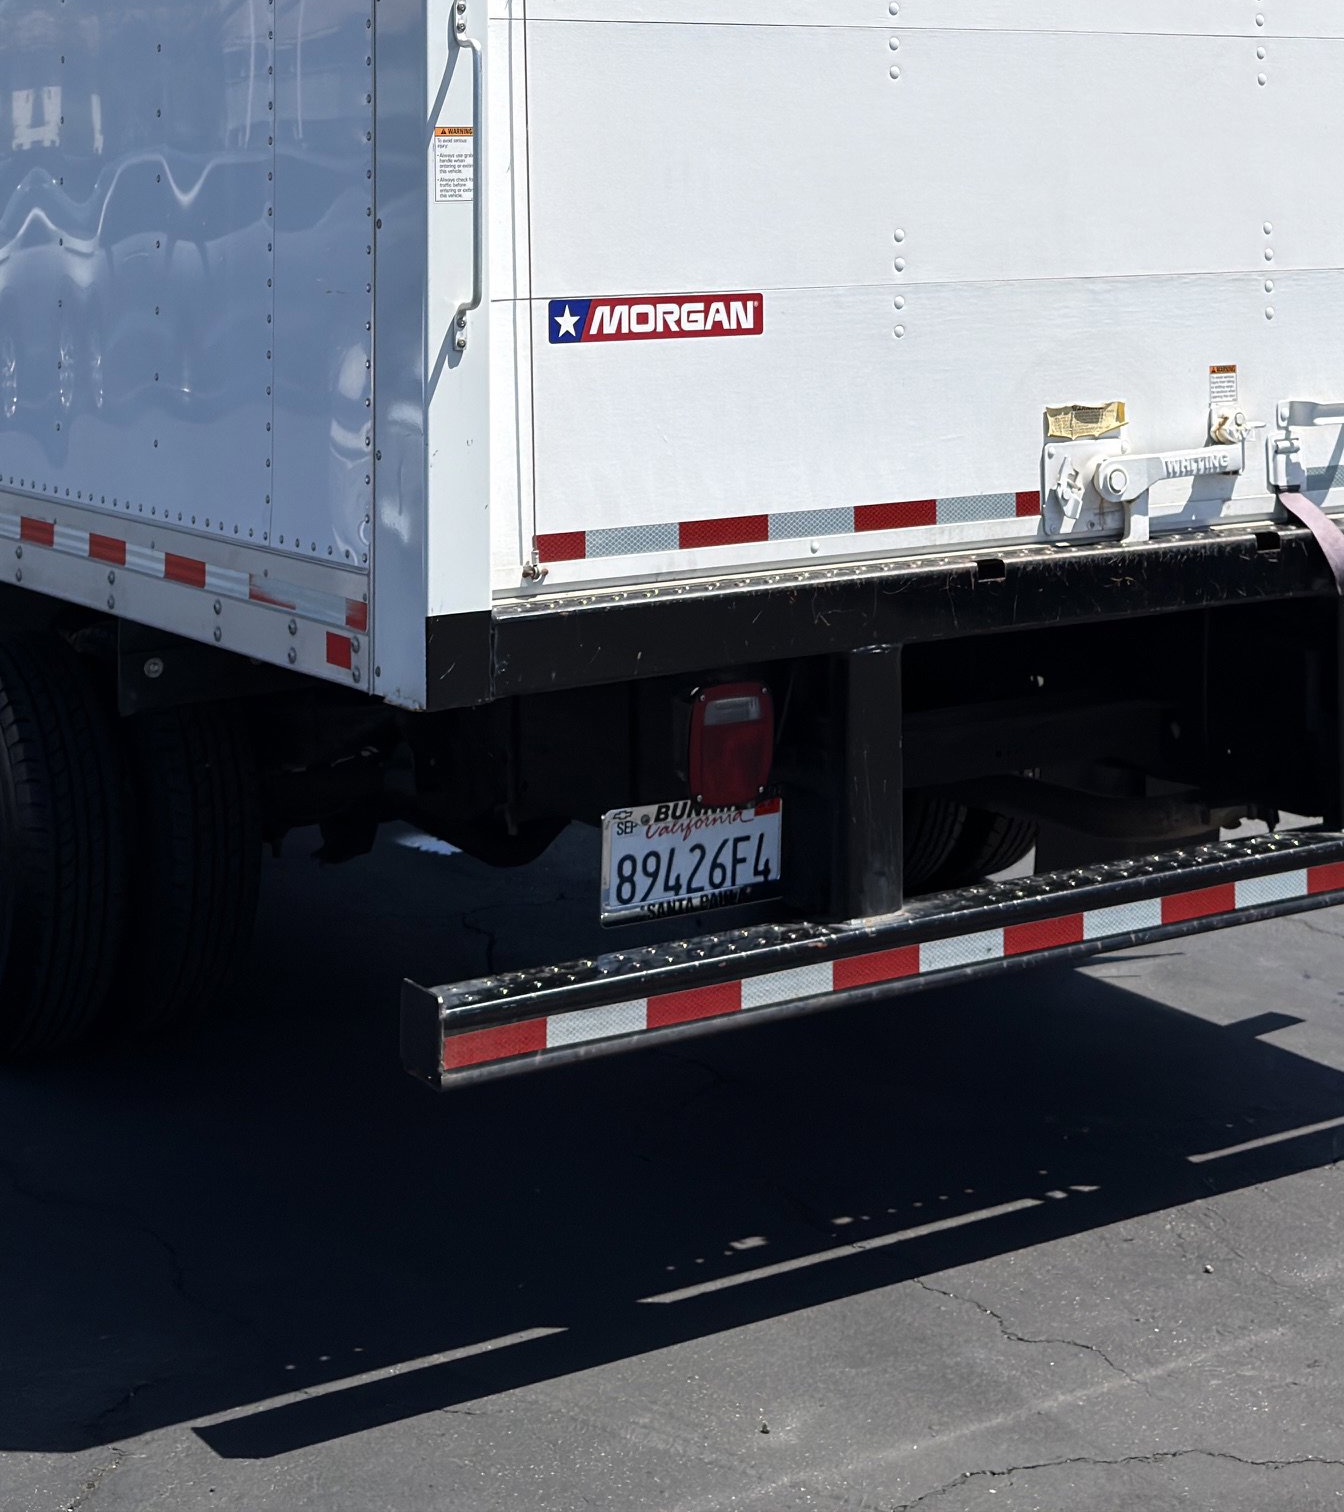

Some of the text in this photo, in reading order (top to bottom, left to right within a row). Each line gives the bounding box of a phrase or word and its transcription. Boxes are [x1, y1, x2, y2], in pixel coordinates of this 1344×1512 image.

[589, 301, 754, 335] MORGAN
[646, 809, 755, 842] California
[615, 832, 772, 906] 89426F4
